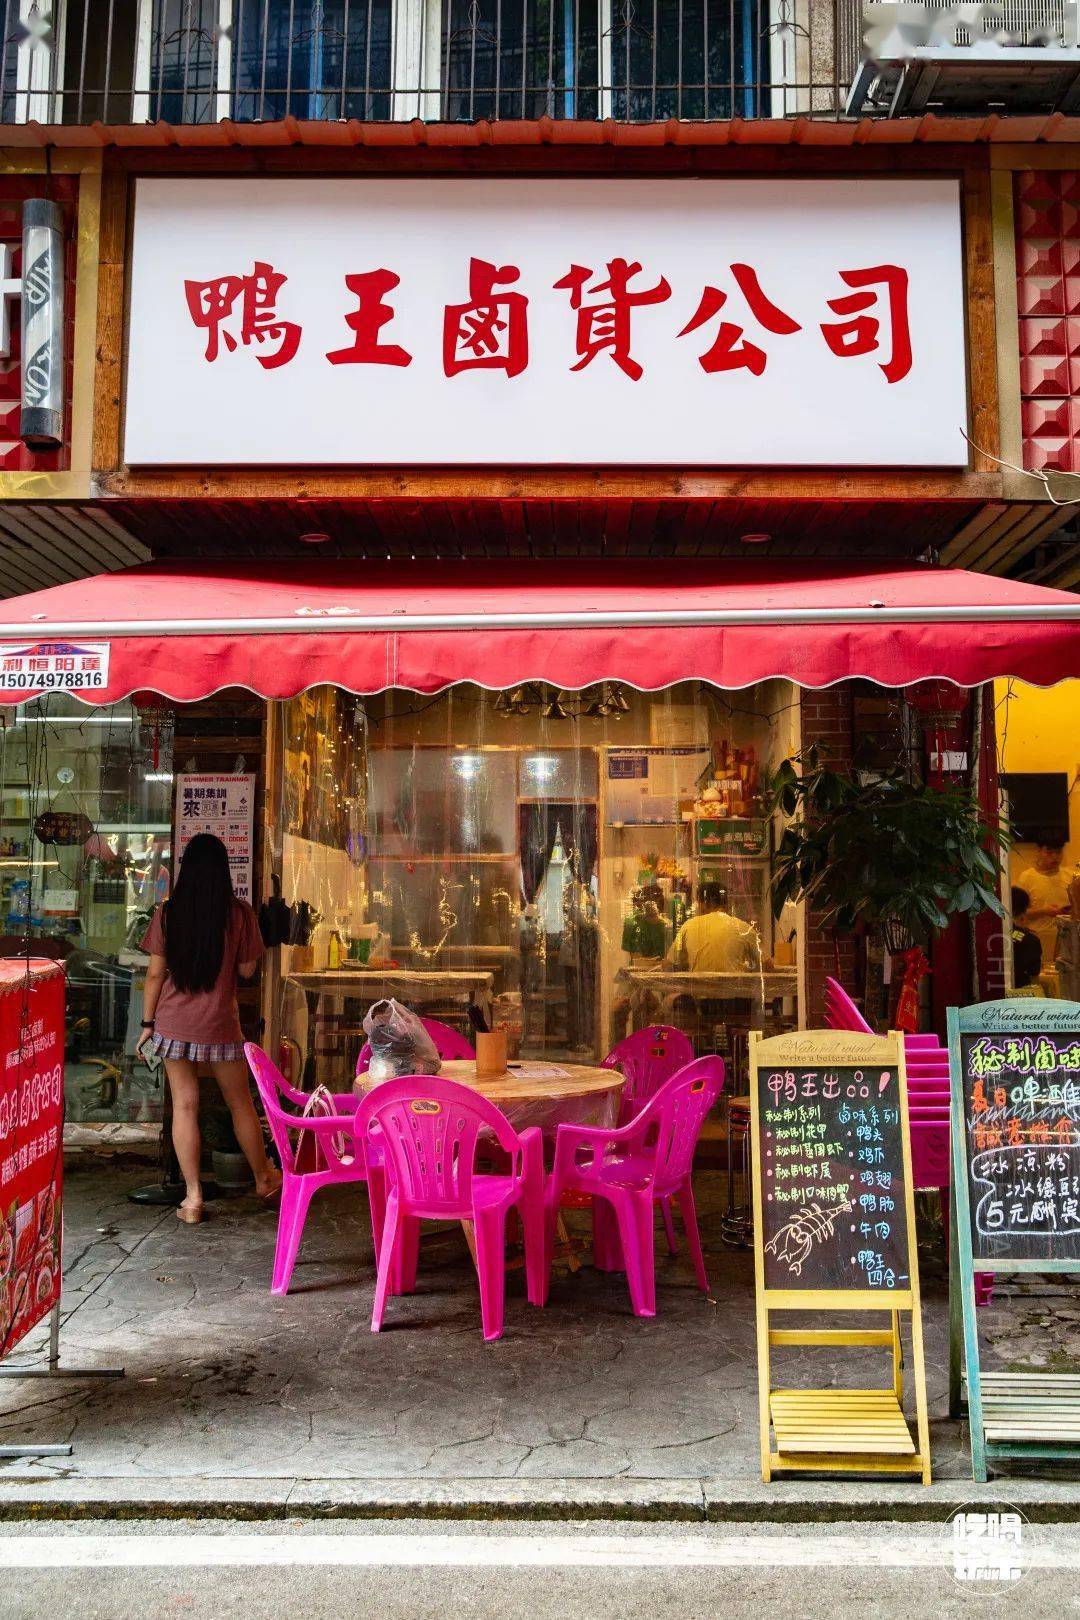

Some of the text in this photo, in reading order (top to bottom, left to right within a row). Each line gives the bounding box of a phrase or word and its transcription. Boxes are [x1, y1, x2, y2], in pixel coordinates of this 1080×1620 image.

[184, 257, 913, 384] 鴨王鹵貨公司
[0, 672, 102, 687] 15074978816
[981, 1006, 1080, 1021] Natural wind
[982, 1022, 1010, 1030] Write
[1021, 1022, 1050, 1030] better
[779, 1039, 876, 1053] Natural wind
[779, 1054, 806, 1062] Write
[816, 1054, 845, 1062] better
[847, 1054, 878, 1062] future
[765, 1105, 821, 1123] 秘制系列
[838, 1102, 899, 1126] 卤味系列
[856, 1125, 884, 1142] 鸭头
[860, 1170, 892, 1190] 鸡翅
[859, 1194, 895, 1214] 鸭肠
[867, 1267, 910, 1288] 四合一
